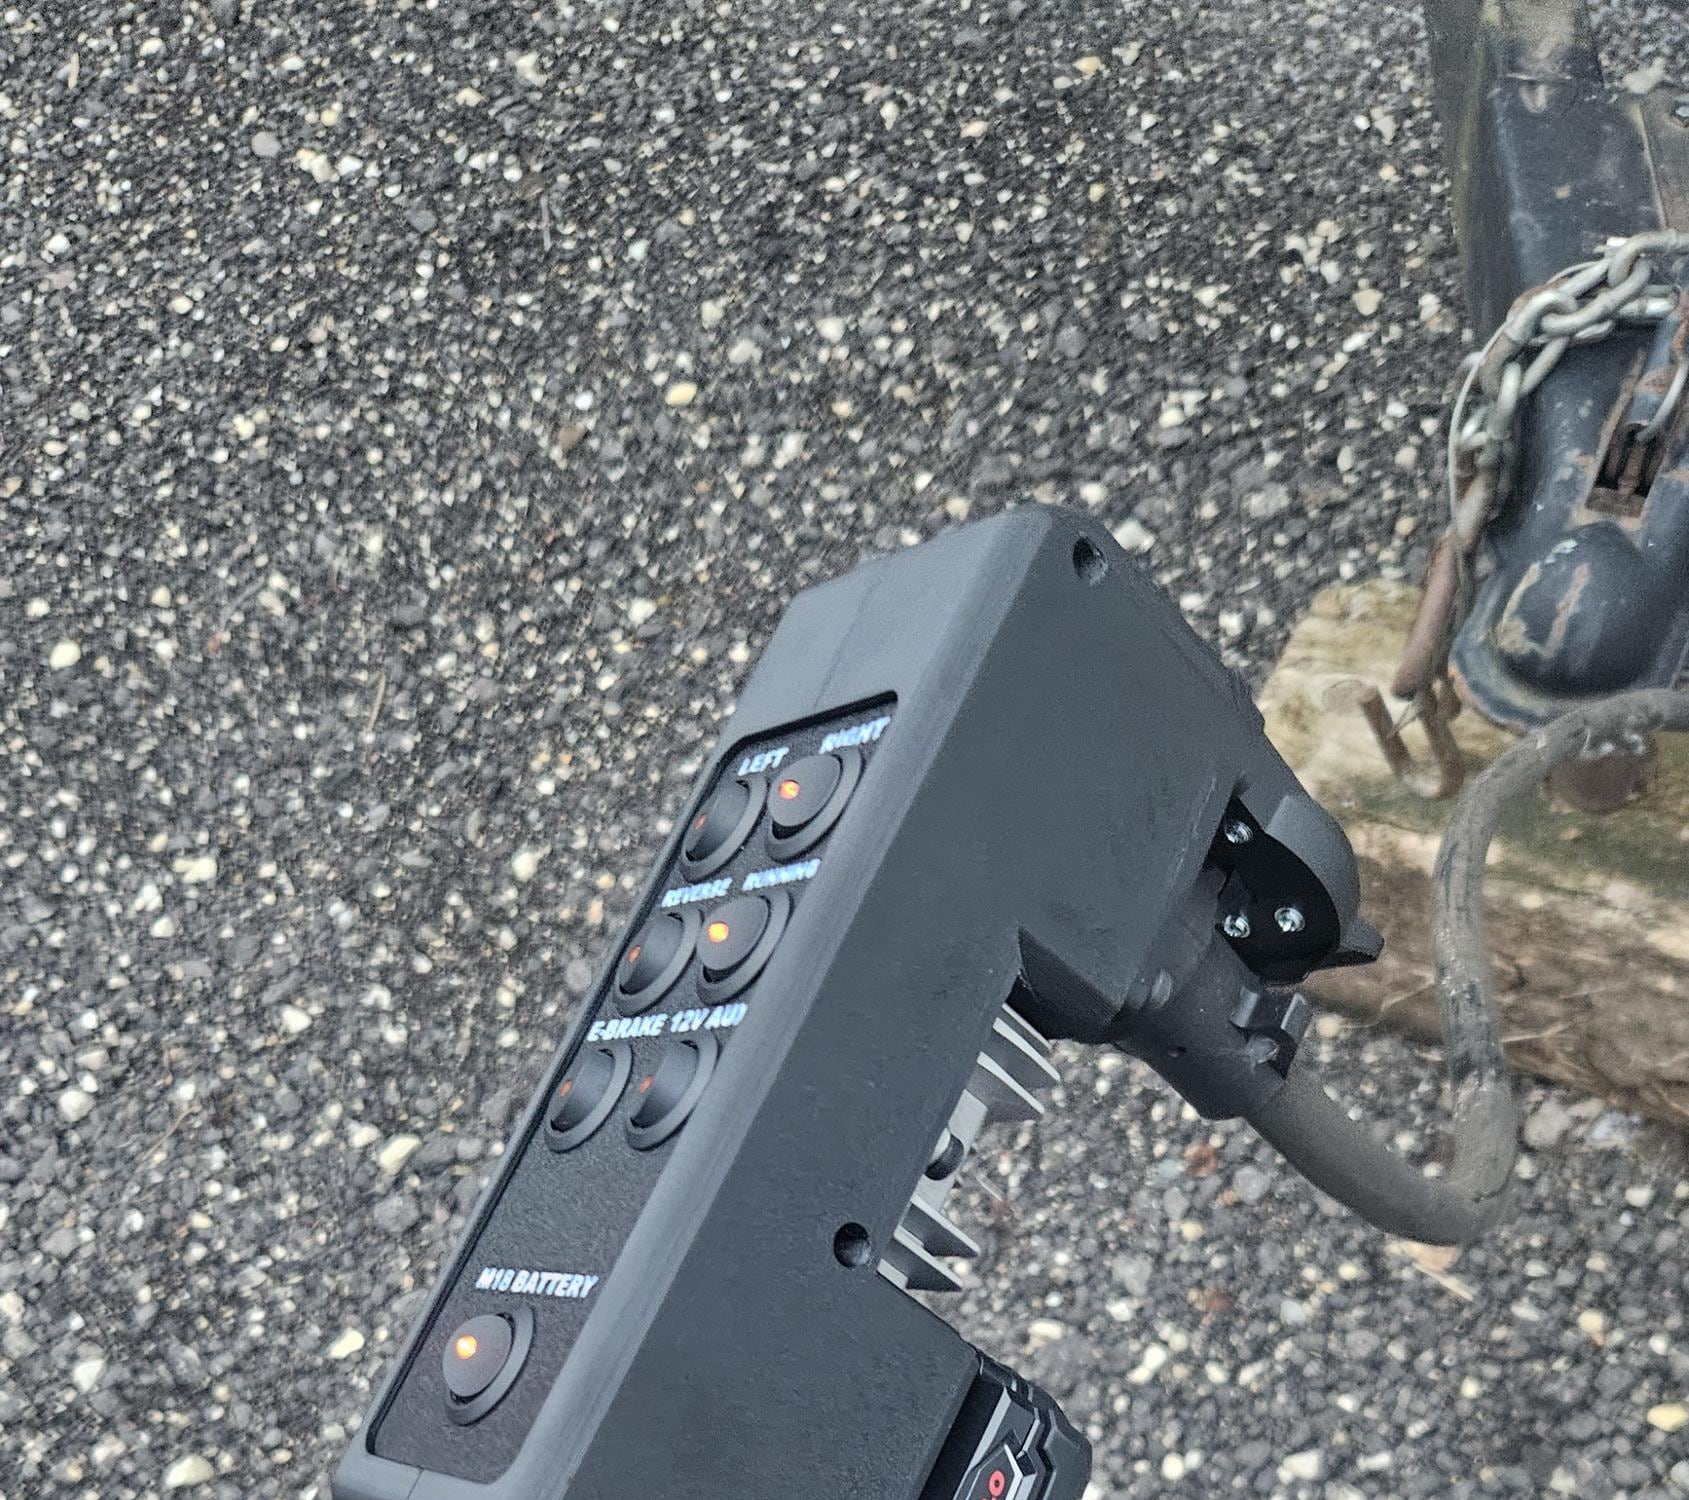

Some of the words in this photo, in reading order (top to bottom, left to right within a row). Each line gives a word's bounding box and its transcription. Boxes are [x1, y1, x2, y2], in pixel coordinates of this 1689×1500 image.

[818, 715, 891, 754] RIGHT
[738, 746, 789, 776] LEFT
[586, 1013, 668, 1041] E-BRAKE
[670, 1007, 710, 1033] 12V
[475, 1267, 515, 1292] M18
[510, 1269, 599, 1298] BATTERY
